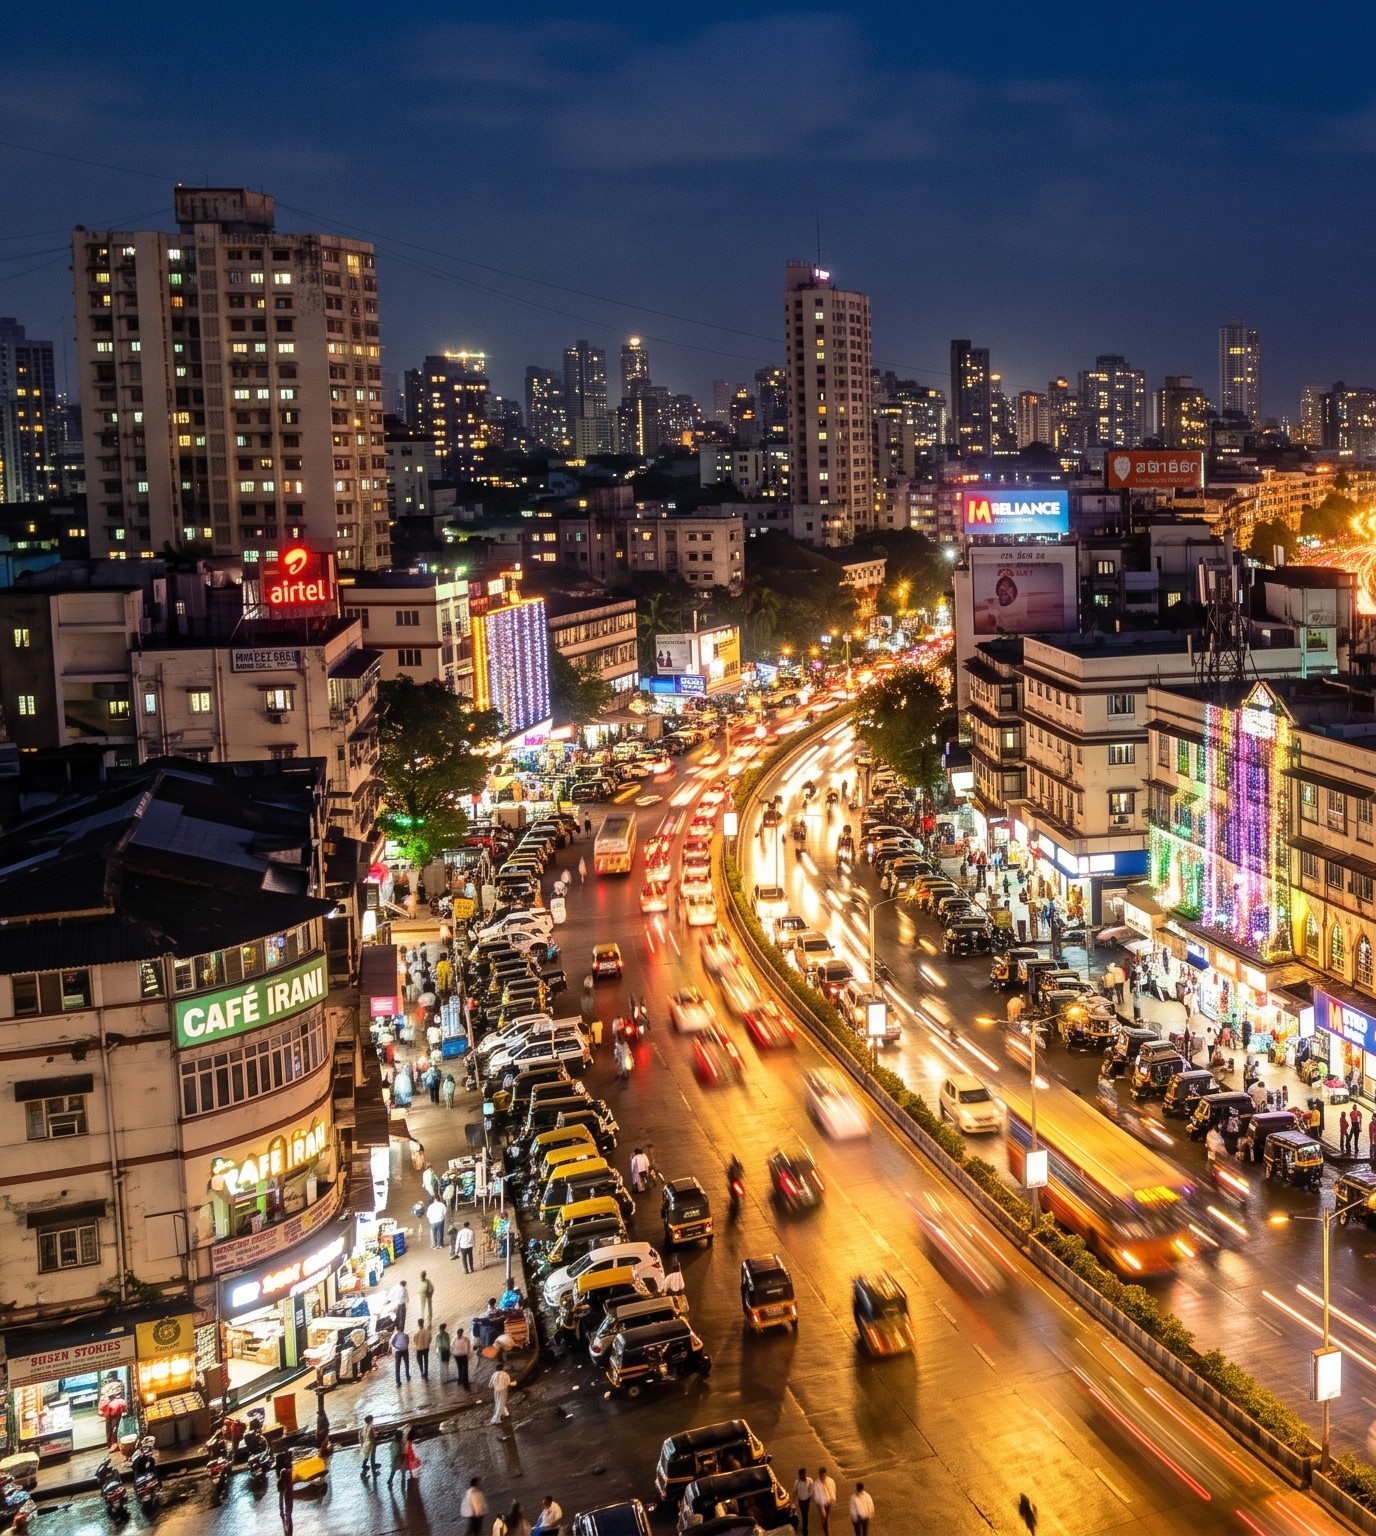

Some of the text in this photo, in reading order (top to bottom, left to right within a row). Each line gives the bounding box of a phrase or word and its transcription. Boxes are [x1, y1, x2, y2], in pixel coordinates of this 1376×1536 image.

[991, 502, 1060, 515] RELIANCE
[271, 580, 325, 603] airtel
[183, 967, 323, 1038] CAFÉ IRANI
[75, 1341, 121, 1358] STORIES
